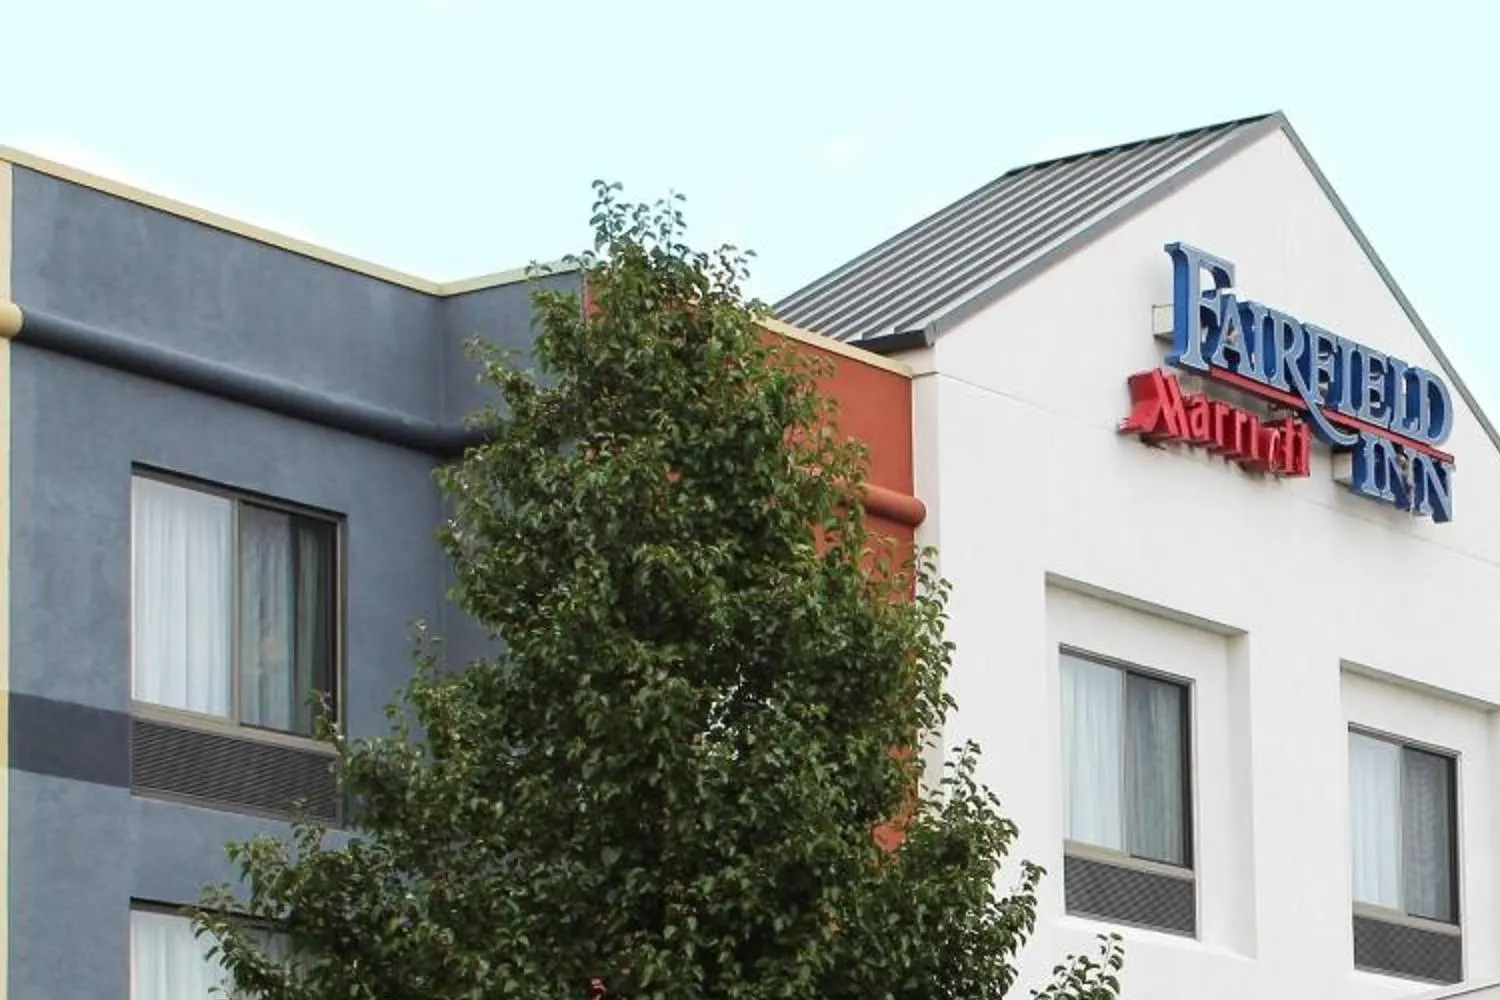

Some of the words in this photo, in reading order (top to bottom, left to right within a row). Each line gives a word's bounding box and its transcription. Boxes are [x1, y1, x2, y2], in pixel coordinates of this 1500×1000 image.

[1164, 242, 1454, 446] FAIRFIELD
[1119, 368, 1311, 477] Marriott
[1350, 434, 1455, 522] INN
